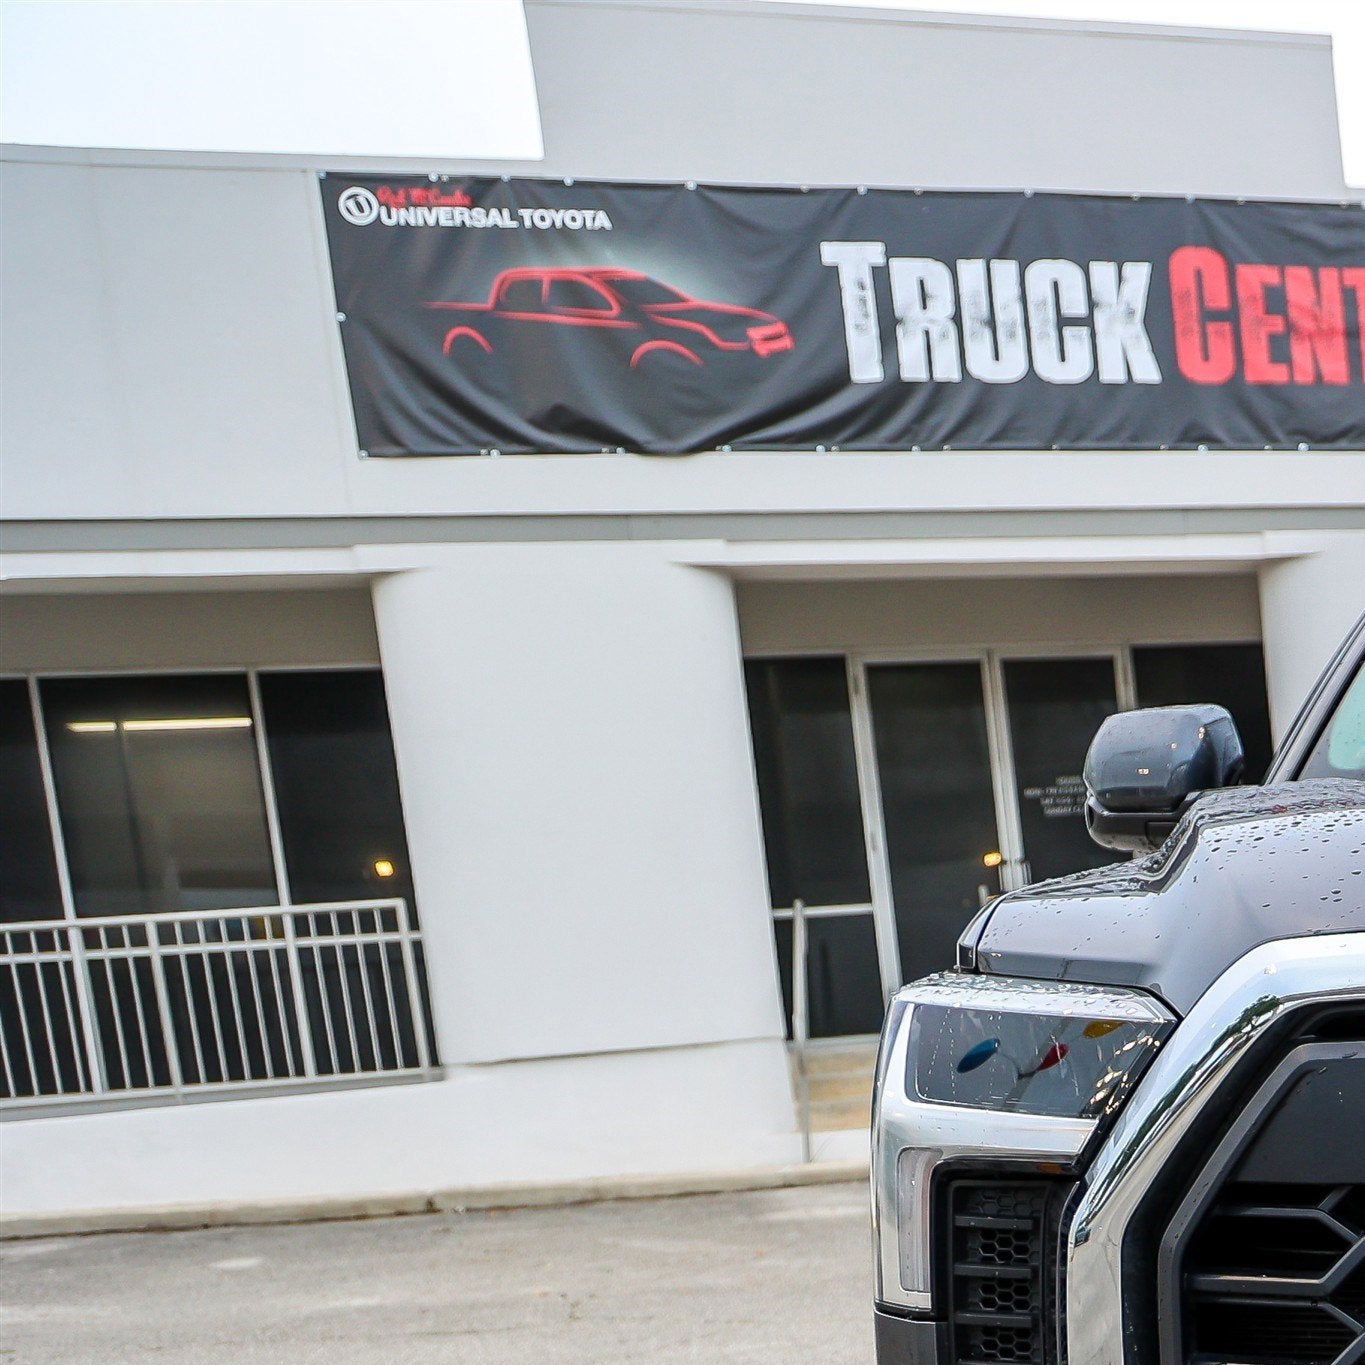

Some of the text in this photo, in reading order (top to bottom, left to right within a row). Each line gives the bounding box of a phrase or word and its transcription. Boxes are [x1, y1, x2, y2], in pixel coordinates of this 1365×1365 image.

[380, 205, 613, 231] UNIVERSAL TOYOTA
[820, 241, 1162, 385] TRUCK
